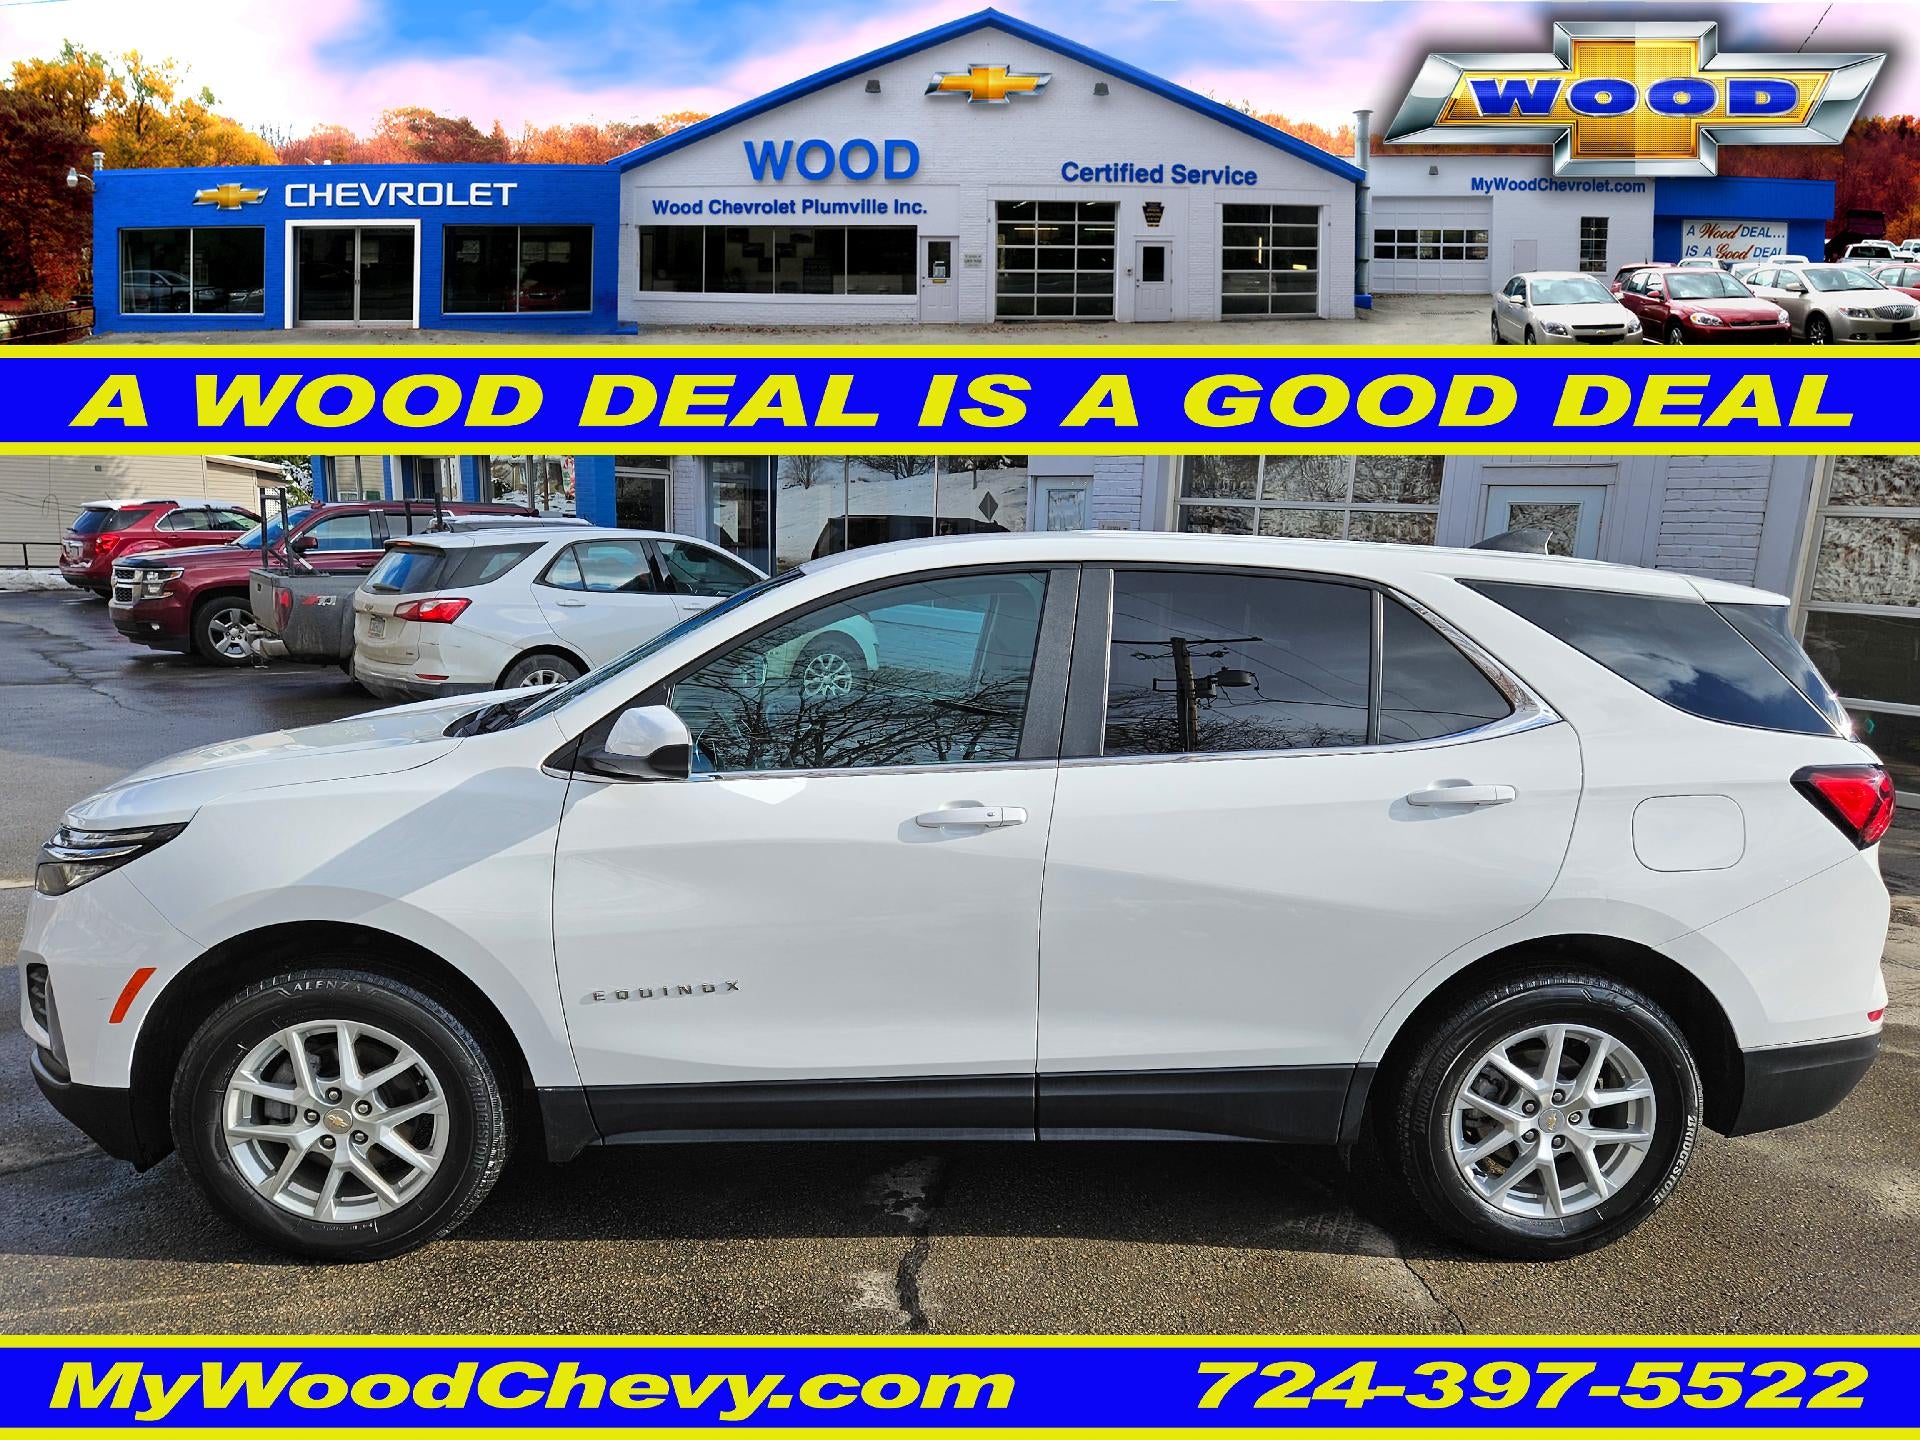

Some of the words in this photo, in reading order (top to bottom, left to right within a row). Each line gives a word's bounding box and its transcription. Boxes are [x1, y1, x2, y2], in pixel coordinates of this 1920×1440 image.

[744, 138, 921, 182] WOOD
[1061, 161, 1164, 185] Certified
[1171, 162, 1258, 186] Service
[285, 183, 518, 207] CHEVROLET
[1471, 176, 1646, 196] MyWoodChevrolet.com
[652, 199, 704, 215] Wood
[708, 198, 796, 215] Chevrolet
[801, 197, 889, 215] Plumville
[893, 198, 928, 215] Inc.
[1686, 224, 1696, 237] A
[1699, 222, 1744, 240] Wood
[1685, 244, 1699, 257] IS
[1703, 245, 1713, 257] A
[1715, 243, 1755, 260] Good
[294, 980, 361, 993] ALENZA
[593, 979, 740, 1000] EQUINOX
[1652, 1114, 1698, 1206] BRIDGESTONE
